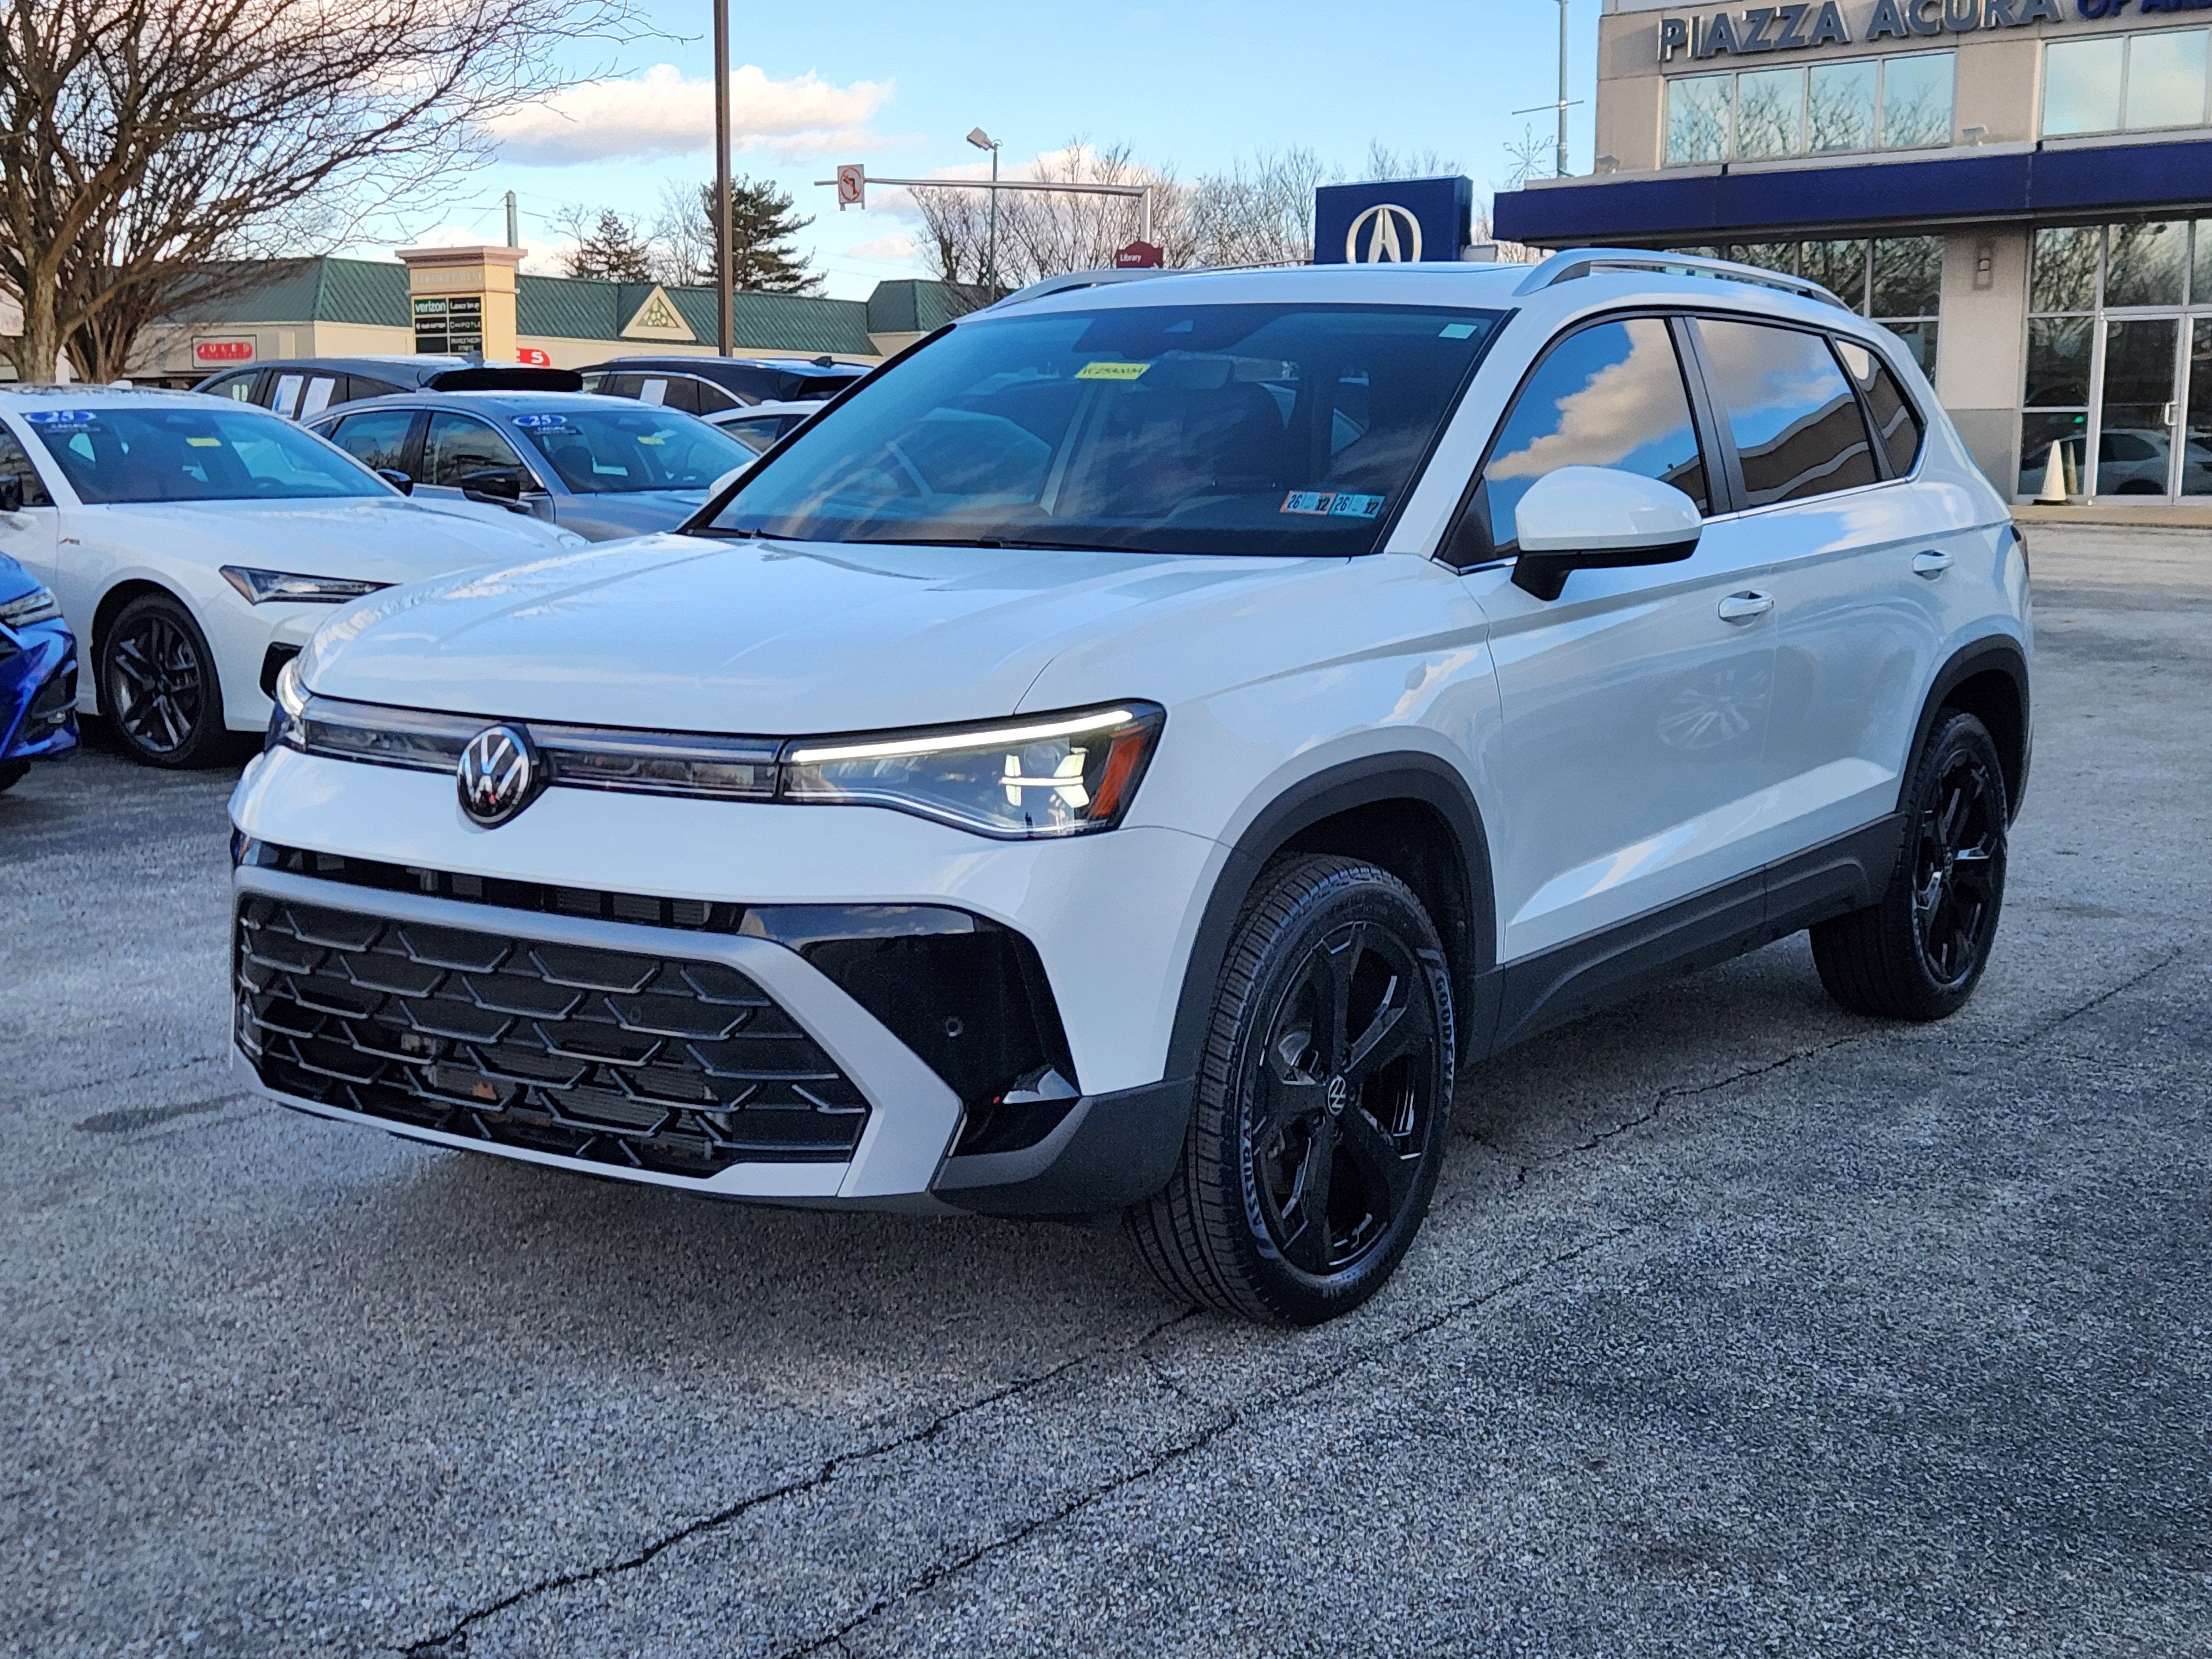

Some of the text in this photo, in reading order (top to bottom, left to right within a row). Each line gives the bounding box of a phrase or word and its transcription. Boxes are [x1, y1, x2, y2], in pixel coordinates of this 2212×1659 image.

[1657, 1, 1850, 60] PIAZZA
[1865, 0, 2063, 35] ACURA
[1120, 253, 1141, 263] Library
[415, 300, 446, 312] verizon
[529, 415, 551, 425] 25
[1287, 494, 1330, 511] 26 12
[1334, 497, 1380, 514] 26 12
